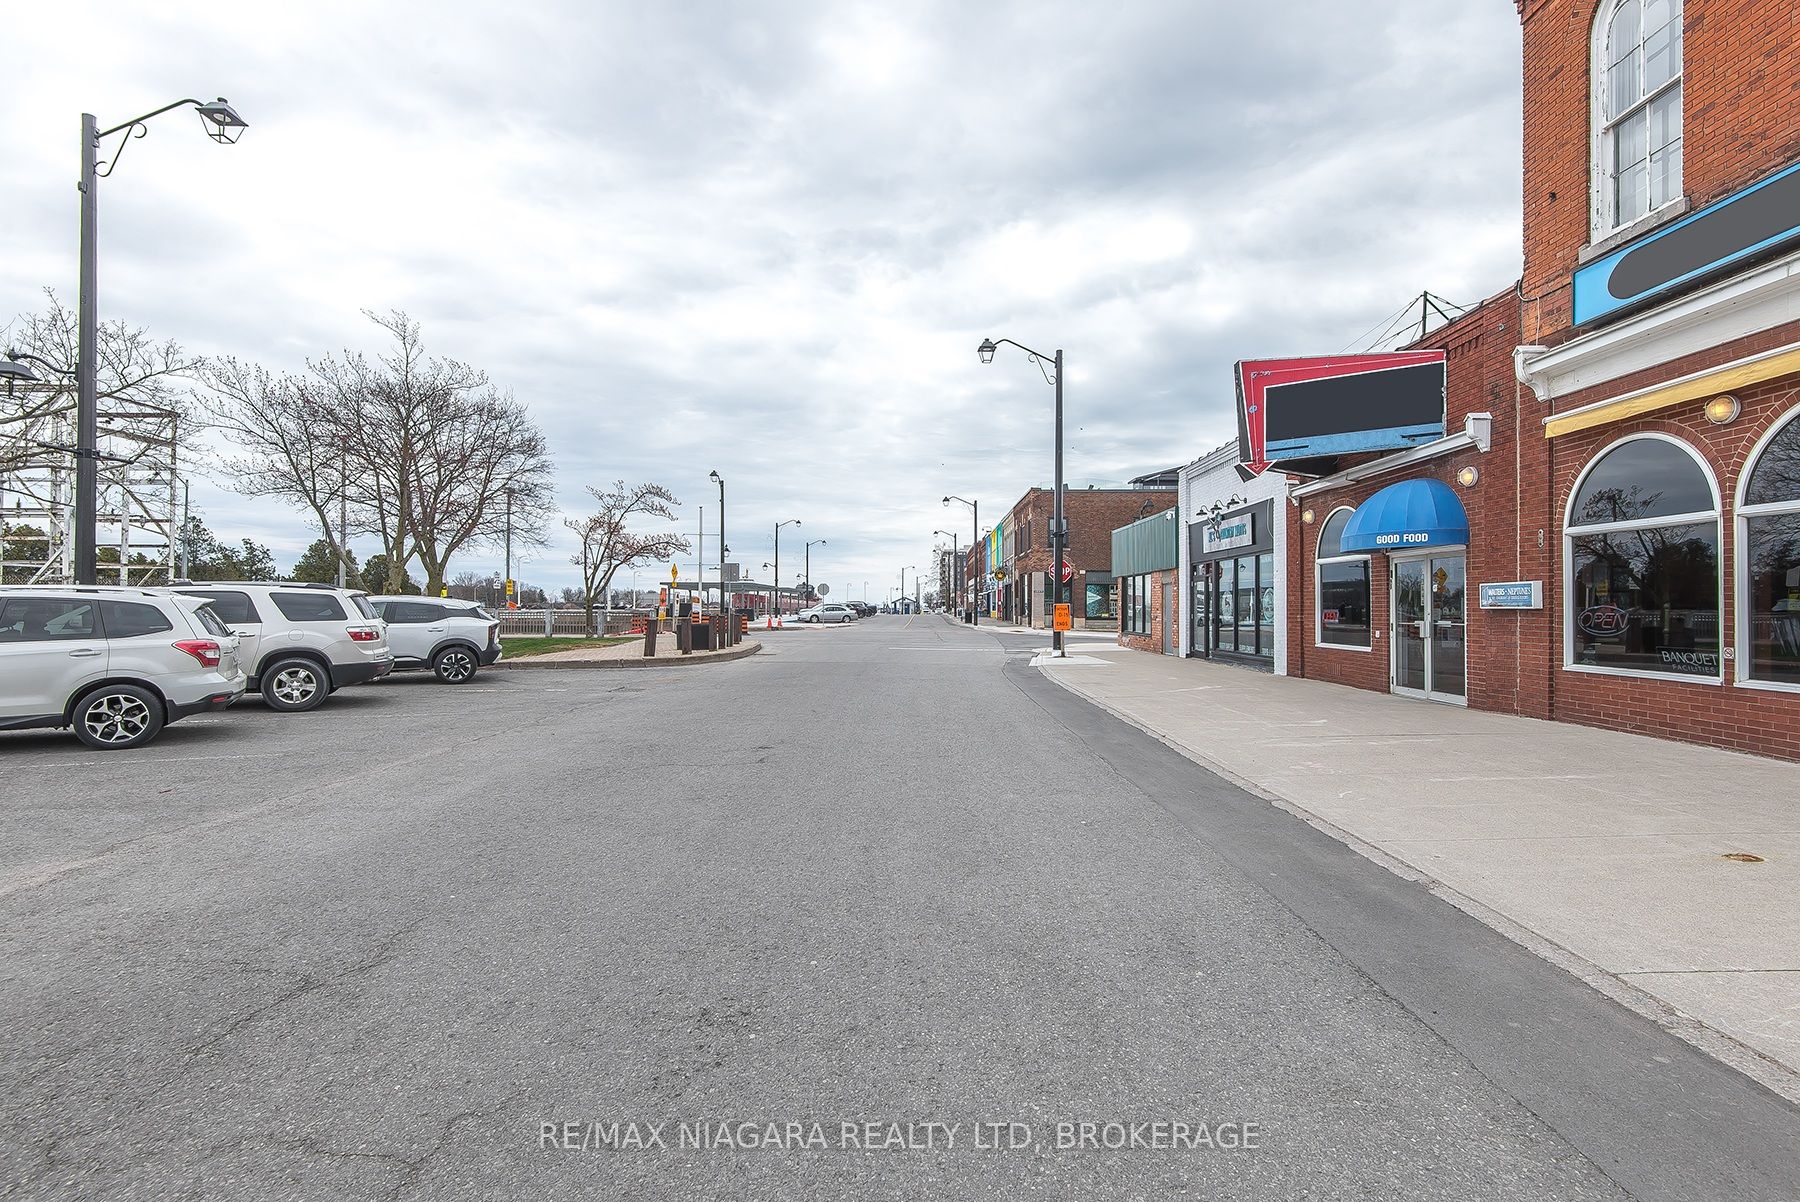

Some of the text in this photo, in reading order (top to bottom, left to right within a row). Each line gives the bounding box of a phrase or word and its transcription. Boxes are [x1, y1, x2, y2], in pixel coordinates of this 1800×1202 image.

[1376, 533, 1429, 544] GOOD FOOD
[1050, 567, 1070, 576] SP
[1580, 611, 1629, 629] OPEN
[1661, 650, 1718, 666] BANQUET
[1671, 664, 1717, 674] FACILITIES
